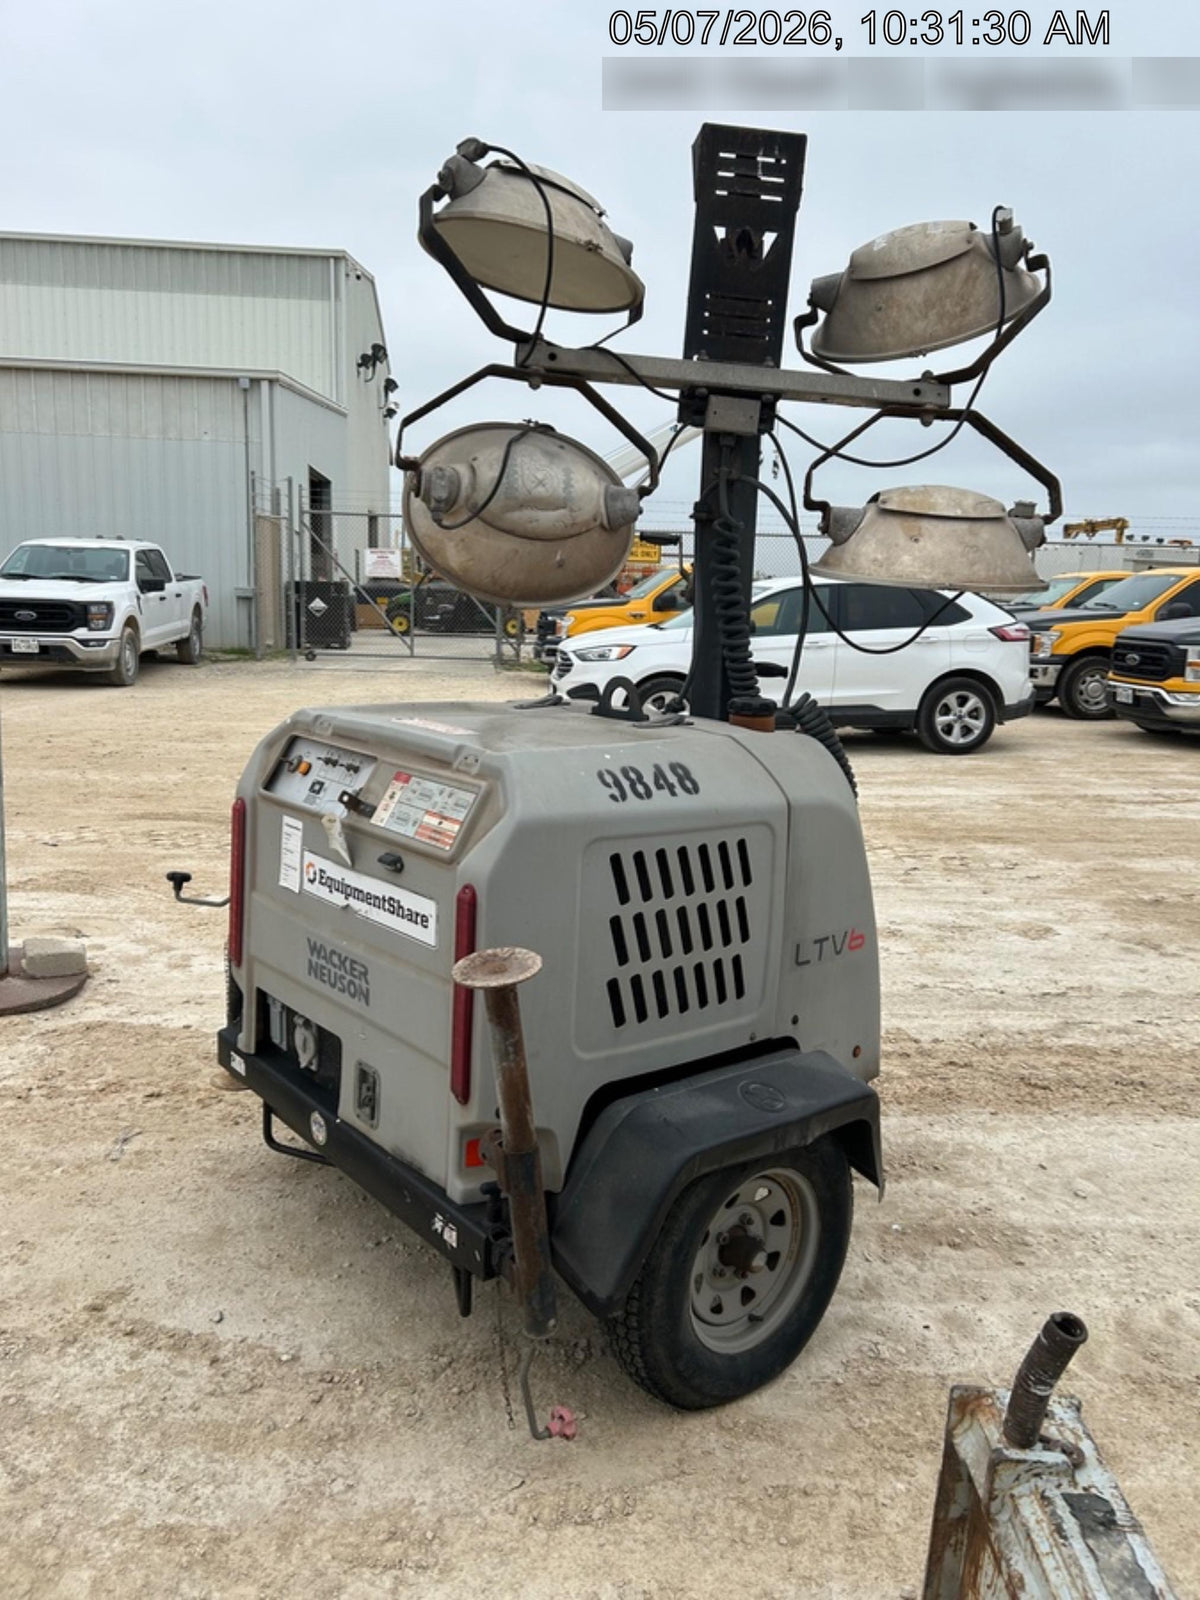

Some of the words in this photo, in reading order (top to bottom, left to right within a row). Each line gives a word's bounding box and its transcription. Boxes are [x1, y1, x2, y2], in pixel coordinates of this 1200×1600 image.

[597, 762, 699, 802] 9848
[318, 869, 429, 928] EquipmentShare
[307, 938, 369, 985] WACKER
[795, 929, 865, 966] LTV6
[308, 960, 370, 1006] NEUSON
